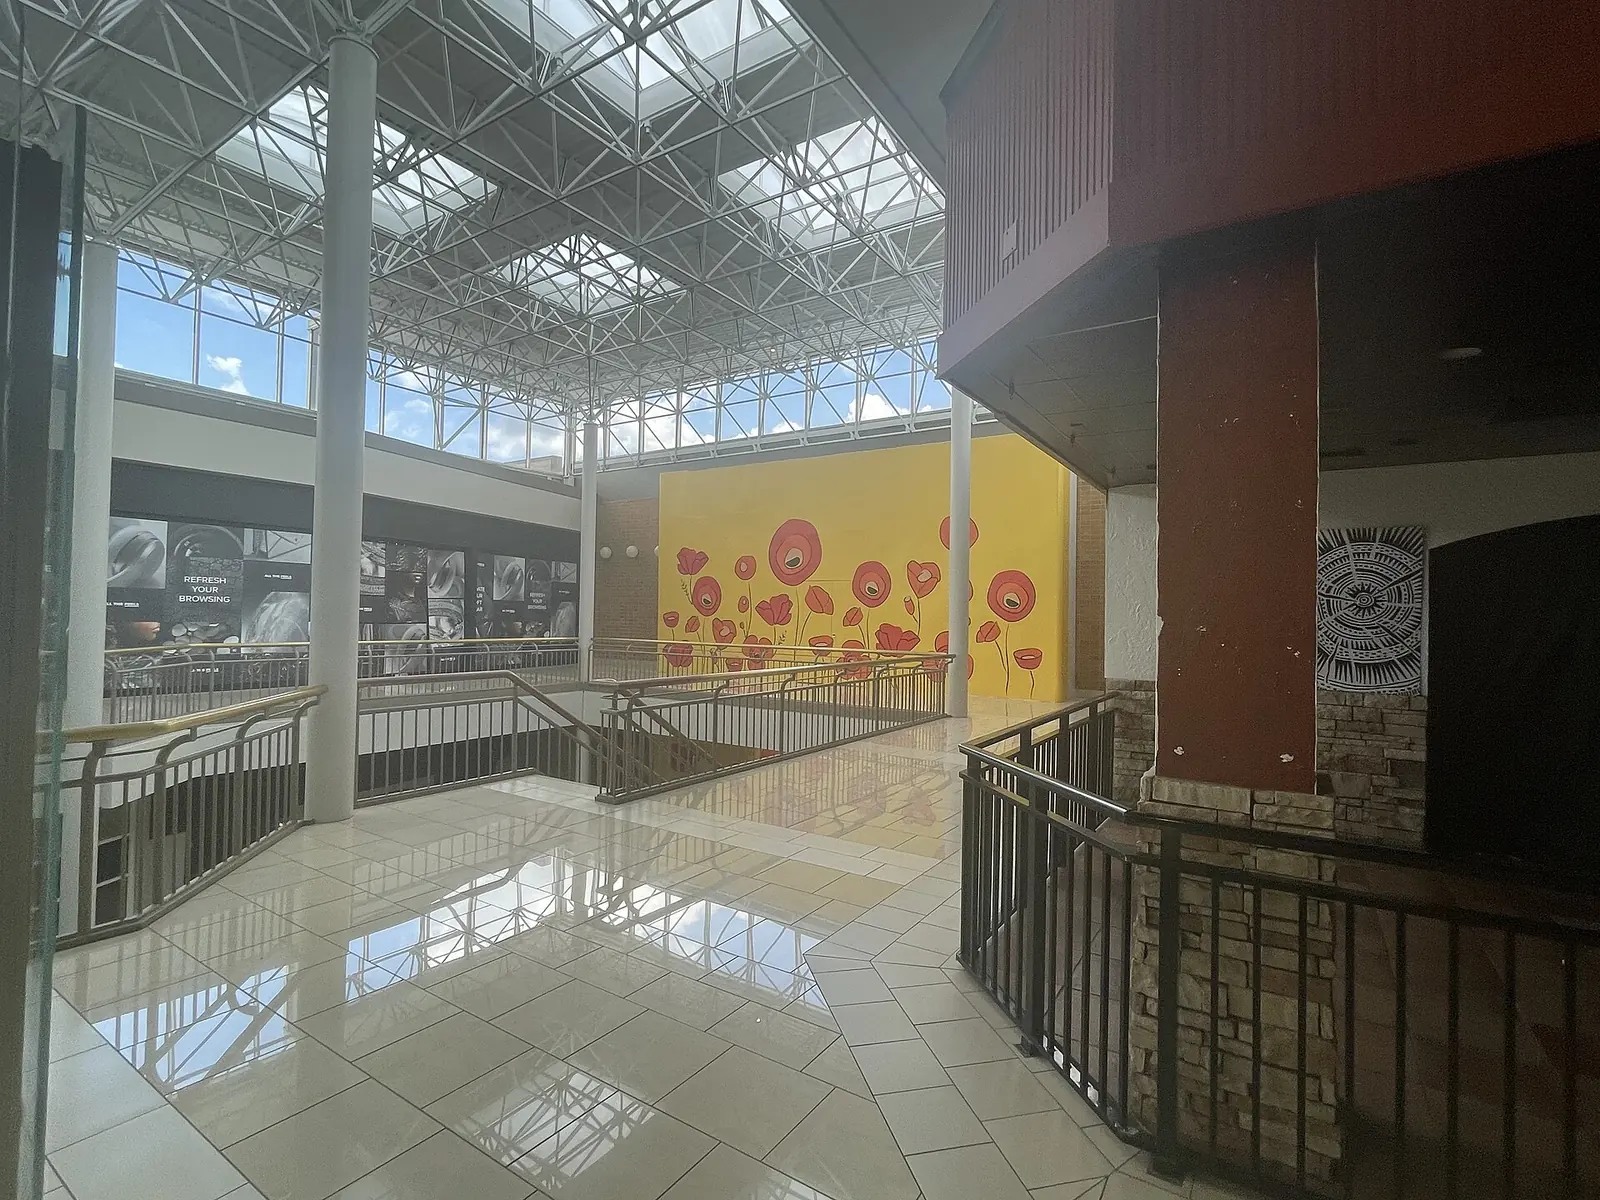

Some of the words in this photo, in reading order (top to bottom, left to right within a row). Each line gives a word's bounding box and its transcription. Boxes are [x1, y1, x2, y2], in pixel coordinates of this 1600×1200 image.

[184, 575, 227, 584] REFRESH
[191, 585, 219, 593] YOUR
[178, 595, 231, 603] BROWSING
